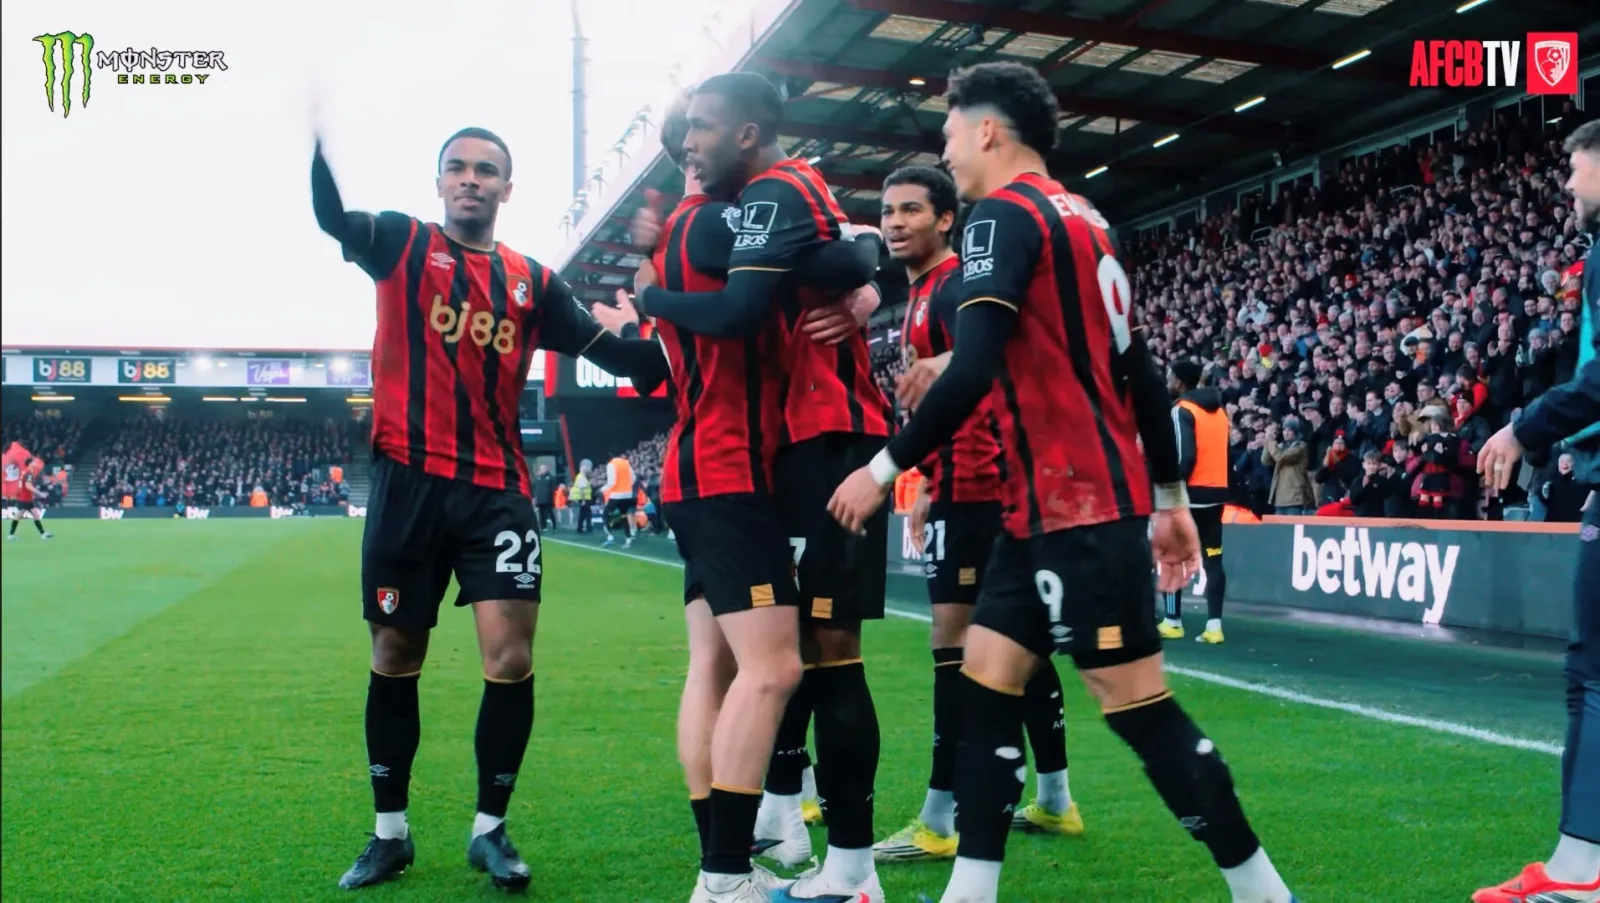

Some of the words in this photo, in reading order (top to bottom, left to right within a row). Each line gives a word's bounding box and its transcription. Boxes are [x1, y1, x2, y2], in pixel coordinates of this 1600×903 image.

[430, 294, 516, 354] bj88
[39, 360, 86, 381] bj88
[494, 529, 541, 574] 22
[923, 520, 946, 562] 21
[1034, 569, 1064, 622] 9
[1292, 524, 1460, 624] betway
